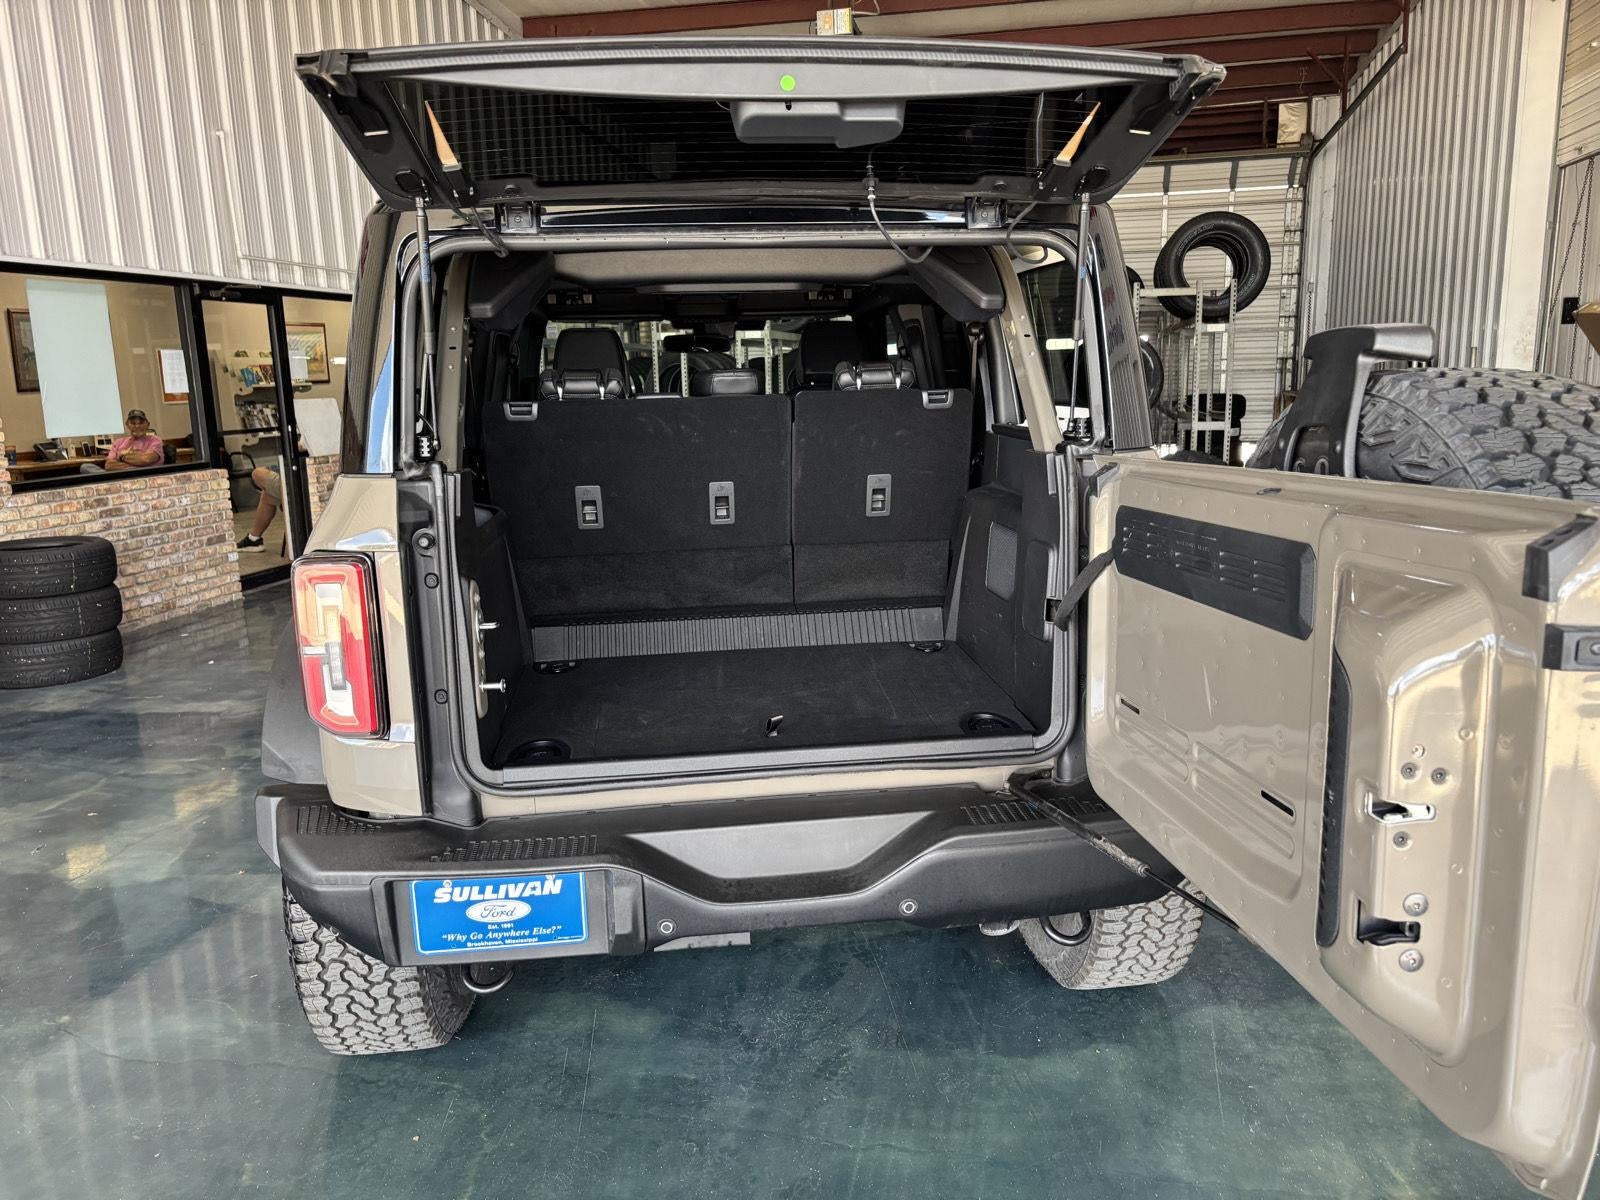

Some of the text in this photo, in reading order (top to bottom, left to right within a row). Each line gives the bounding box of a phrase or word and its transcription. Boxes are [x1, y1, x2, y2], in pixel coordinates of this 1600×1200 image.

[434, 879, 563, 903] SULLIVAN
[480, 904, 516, 919] Ford
[470, 932, 483, 940] Go
[486, 929, 530, 940] Anywhere
[505, 936, 539, 944] Mississippi
